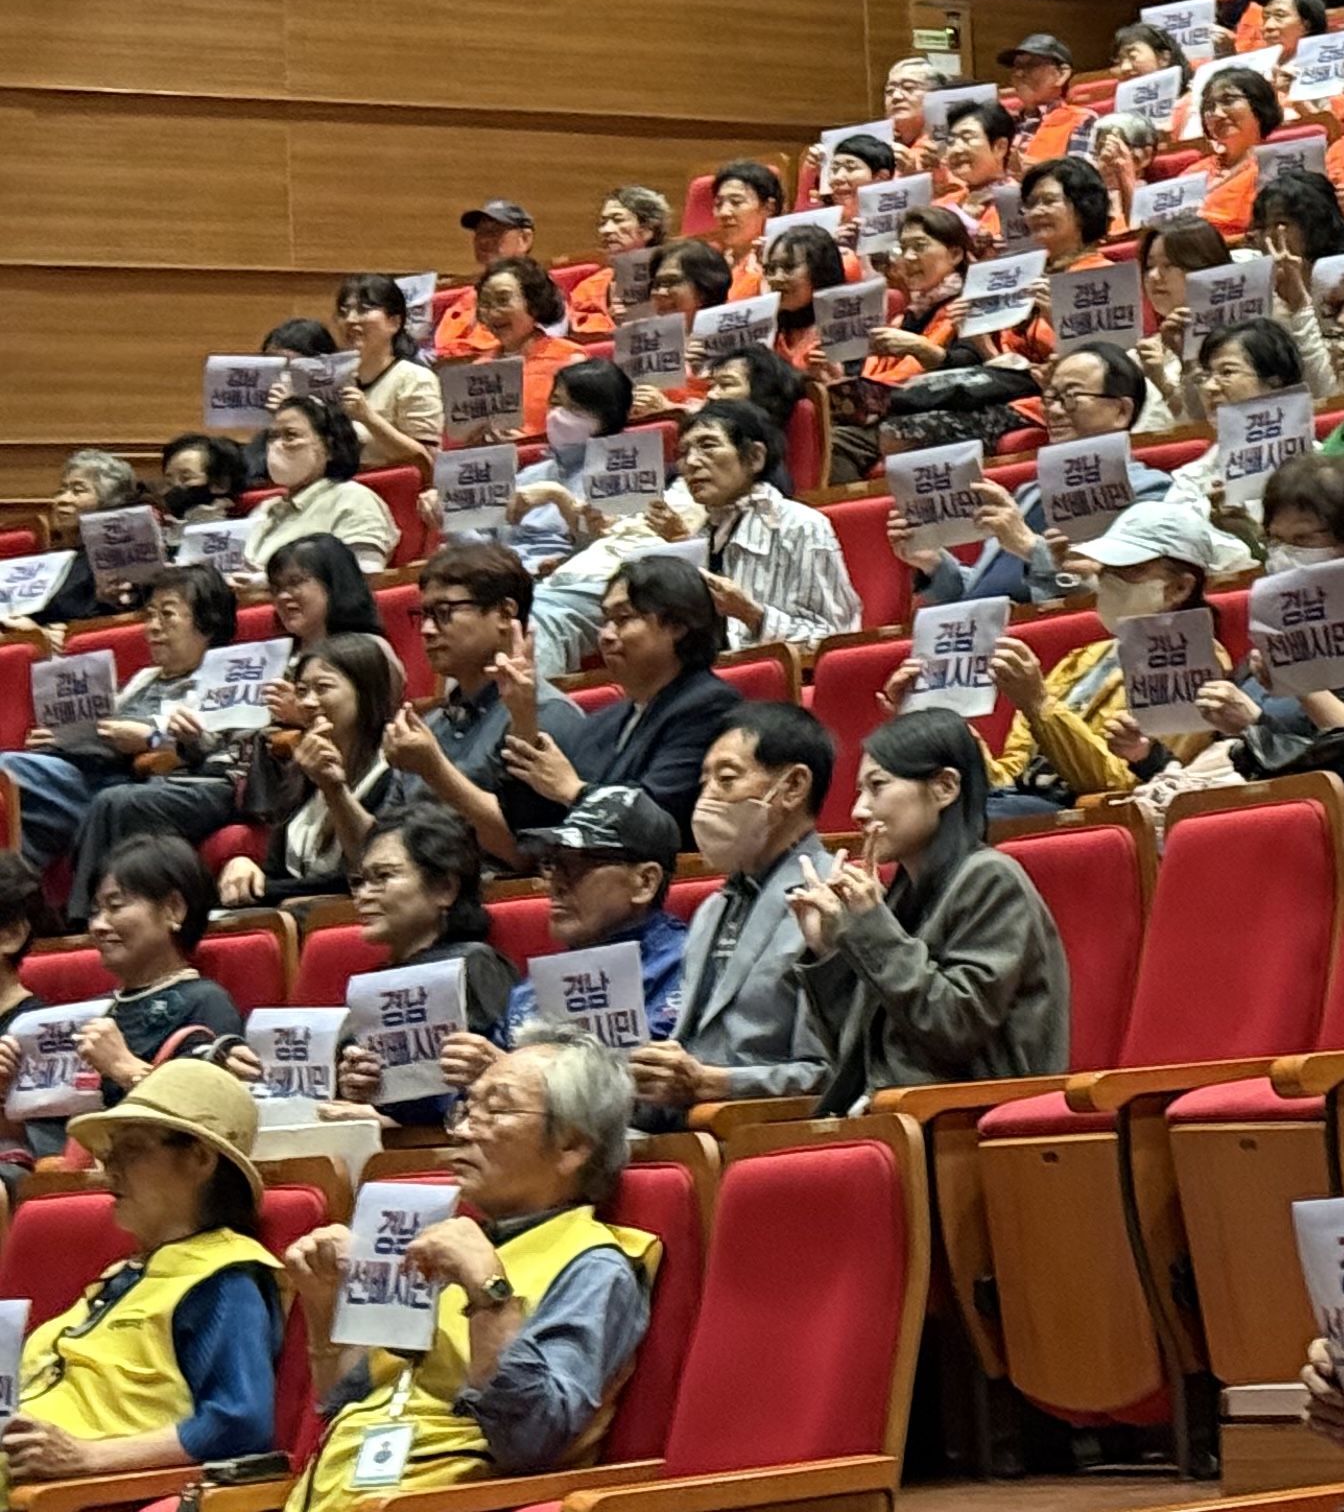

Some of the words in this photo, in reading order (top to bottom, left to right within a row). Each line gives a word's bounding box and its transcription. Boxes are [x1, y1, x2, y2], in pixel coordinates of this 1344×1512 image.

[1059, 305, 1133, 340] 선배시민
[1246, 407, 1284, 442] 경남
[1064, 453, 1101, 485] 경남
[1052, 484, 1131, 523] 선배시민
[1280, 587, 1326, 626] 경남
[935, 620, 977, 654] 경남
[1147, 634, 1187, 667] 경남
[379, 988, 428, 1026] 경남
[562, 973, 610, 1009] 경남
[273, 1026, 312, 1060] 경남
